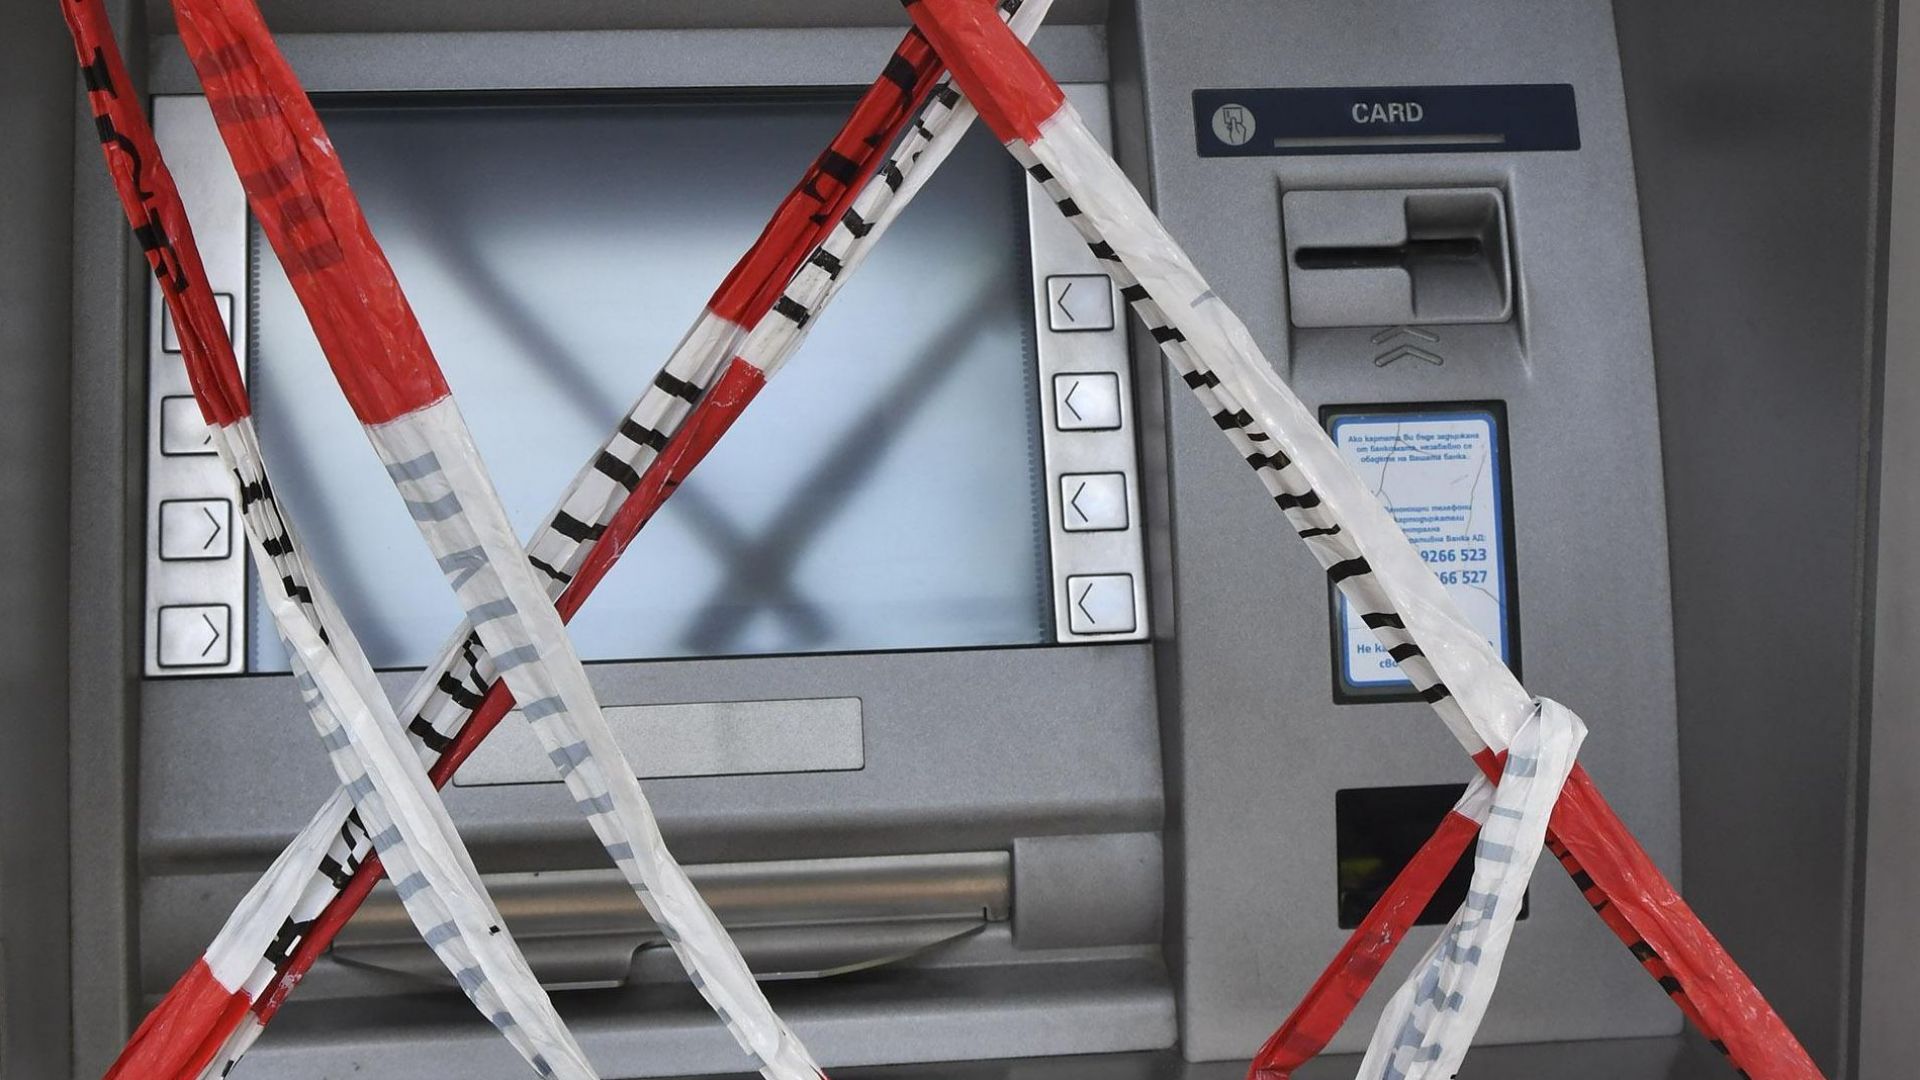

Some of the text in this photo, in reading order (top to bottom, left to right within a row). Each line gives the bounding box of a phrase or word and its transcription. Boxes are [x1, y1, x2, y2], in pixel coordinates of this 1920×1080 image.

[1351, 102, 1424, 124] CARD
[1460, 548, 1487, 562] 523
[1462, 570, 1488, 584] 527
[1357, 643, 1372, 654] Не
